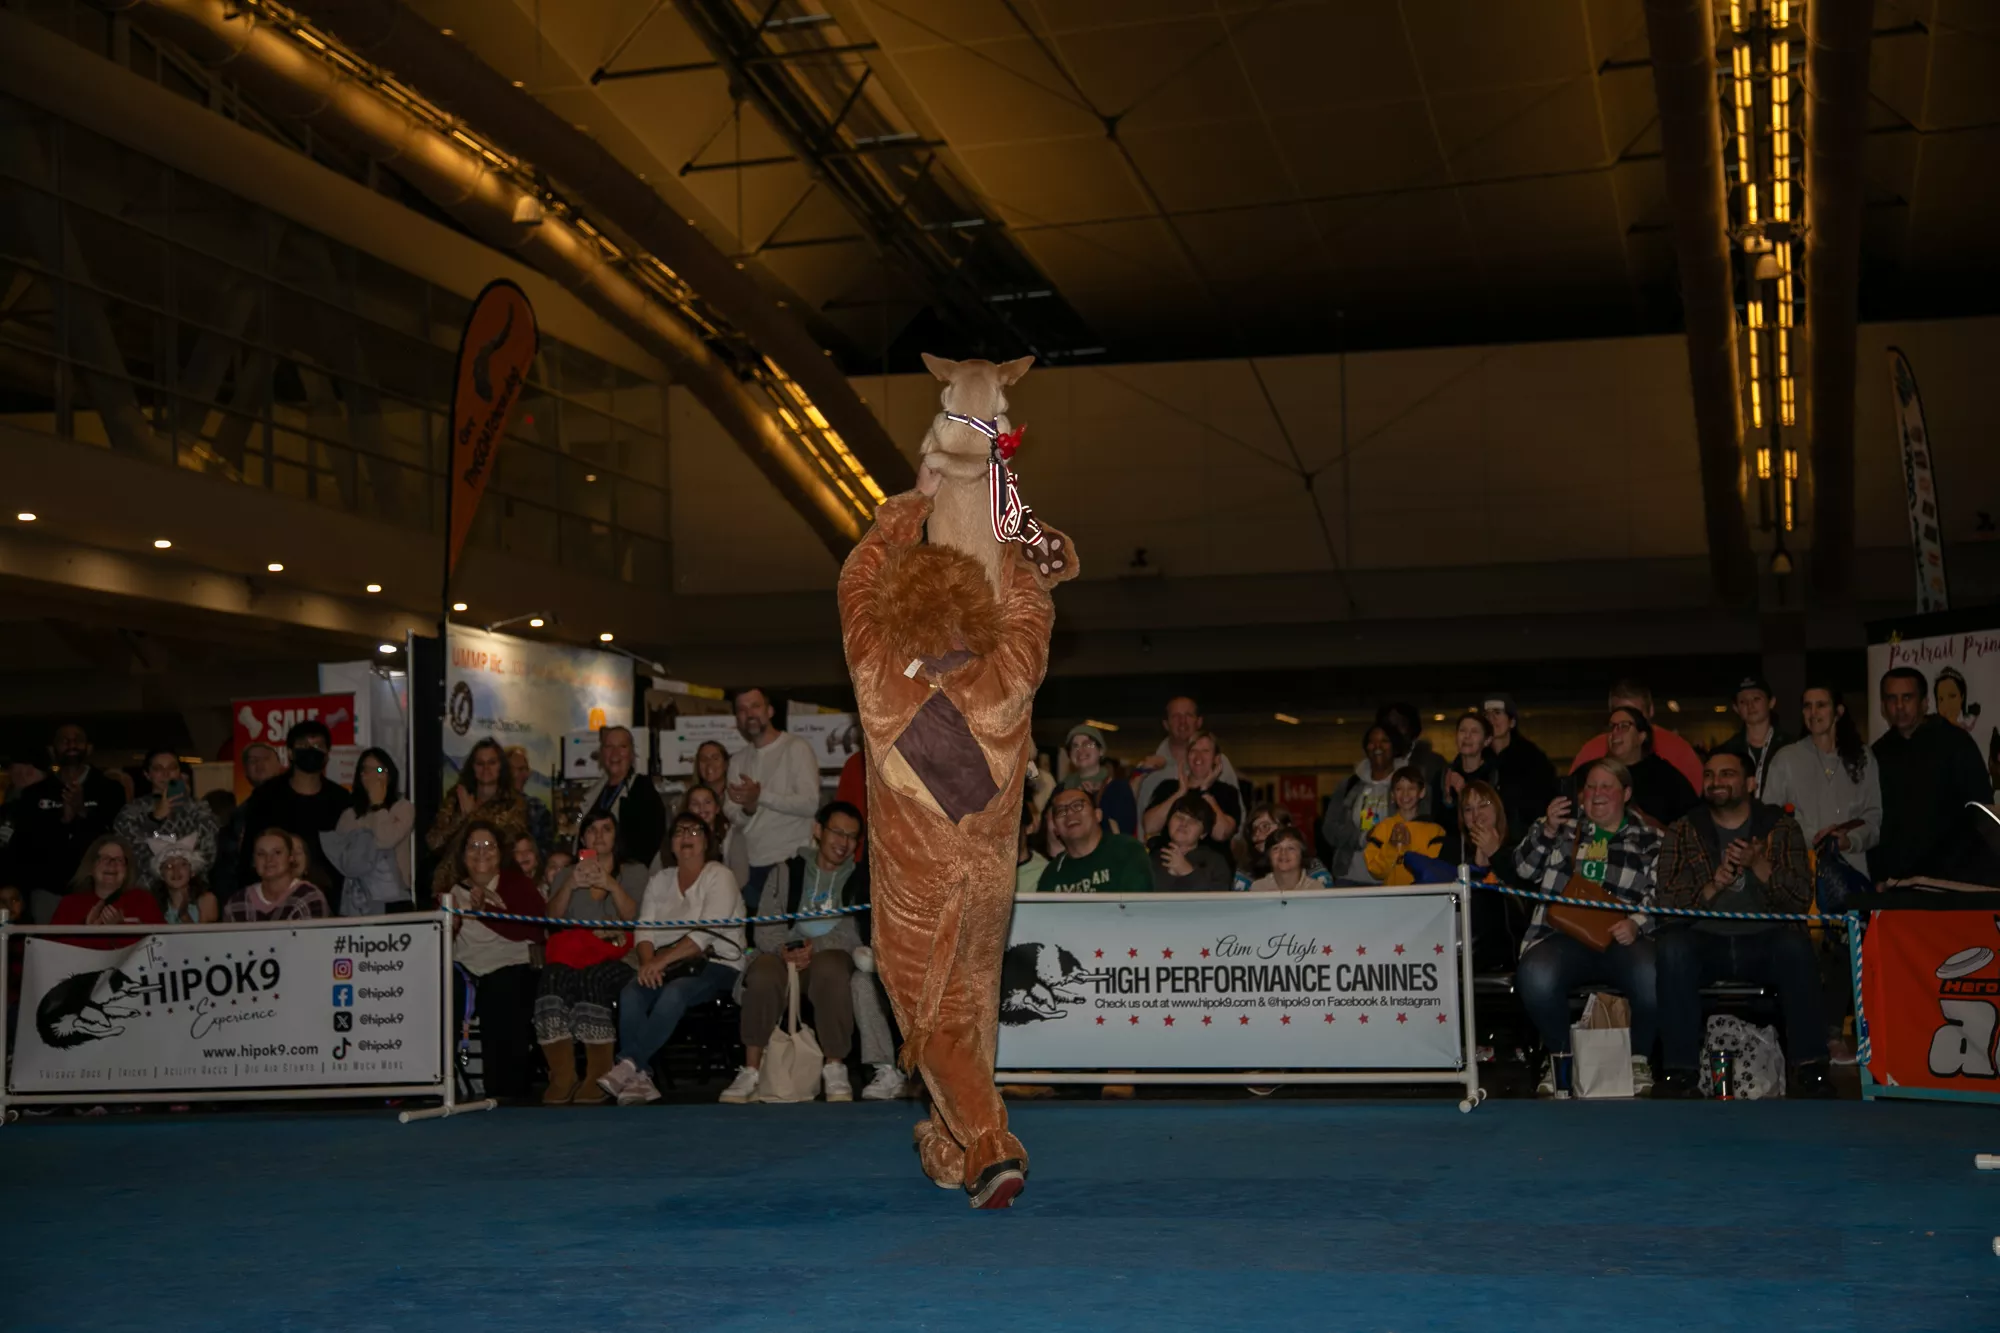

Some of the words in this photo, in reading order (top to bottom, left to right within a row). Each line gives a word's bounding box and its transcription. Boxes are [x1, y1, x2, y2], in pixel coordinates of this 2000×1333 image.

[1888, 637, 1956, 672] Portrait
[1962, 635, 2000, 664] Prin
[334, 933, 412, 958] #hipok9
[1215, 934, 1253, 958] Aim
[1256, 933, 1318, 963] High
[358, 960, 405, 976] @hipok9
[140, 957, 281, 1006] HIPOK9
[1095, 966, 1150, 994] HIGH
[1156, 964, 1332, 994] PERFORMANCE
[1336, 963, 1439, 992] CANINES
[1943, 980, 2000, 994] Hero
[357, 986, 405, 1001] @hipok9
[1094, 998, 1127, 1009] Check
[1128, 999, 1141, 1008] us
[1142, 999, 1158, 1008] out
[1160, 999, 1170, 1008] at
[1171, 997, 1257, 1010] www.hipok9.com
[1258, 997, 1267, 1007] &
[1268, 996, 1311, 1010] @hipok9
[1312, 998, 1324, 1007] on
[1327, 996, 1378, 1008] Facebook
[1380, 996, 1389, 1007] &
[1390, 995, 1441, 1009] Instagram
[190, 997, 277, 1040] Experience
[359, 1012, 405, 1028] @hipok9
[358, 1039, 403, 1054] @hipok9
[1928, 998, 2000, 1080] a
[203, 1043, 319, 1059] www.hipok9.com
